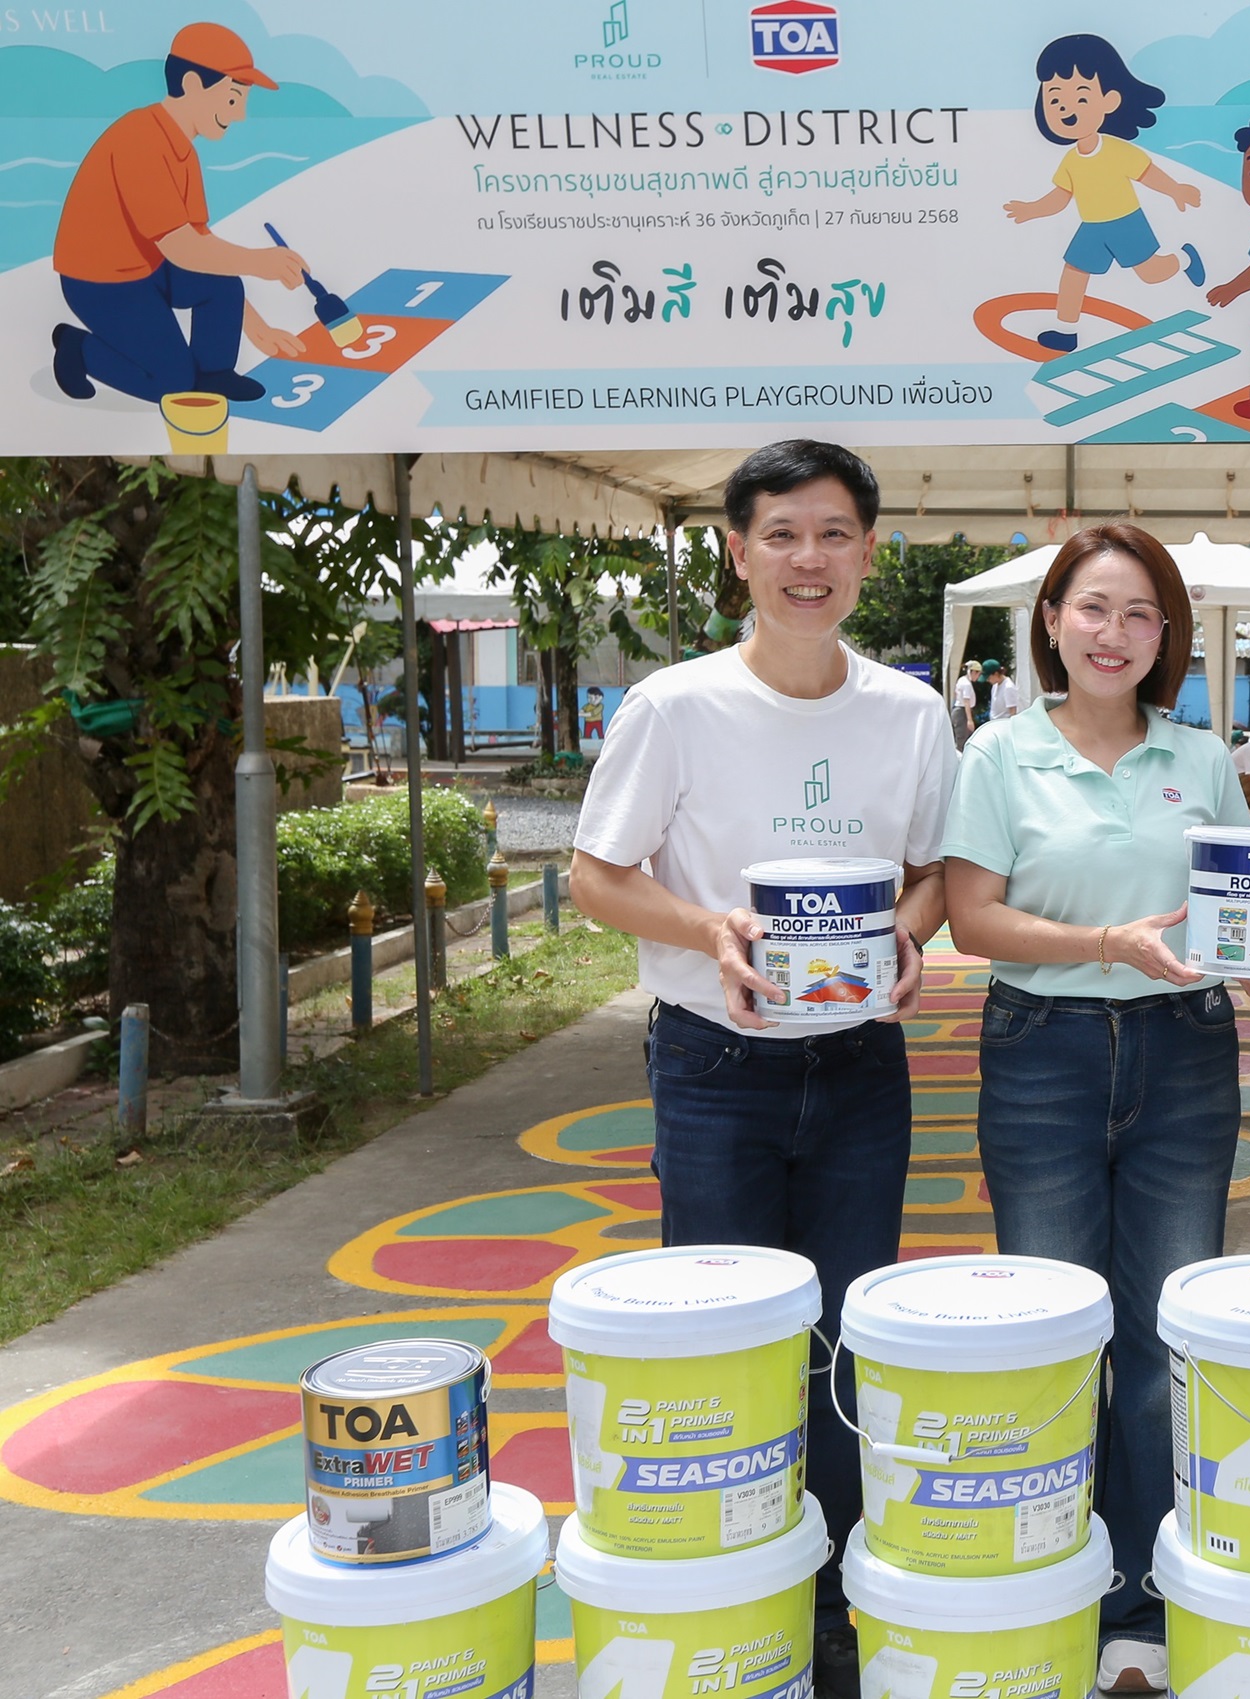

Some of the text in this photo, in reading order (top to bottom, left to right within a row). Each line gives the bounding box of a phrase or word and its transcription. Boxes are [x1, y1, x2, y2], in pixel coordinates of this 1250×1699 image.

[0, 9, 116, 33] S WELL
[754, 22, 835, 53] TOA
[574, 54, 662, 69] PROUD
[455, 107, 969, 150] WELLNESS DISTRICT
[473, 157, 958, 199] โครงการชุมชนสุขภาพดี สู่ความสุขที่ยั่งยืน
[477, 208, 959, 233] ณ โรงเรียนราชประชานุเคราะห์ 36 จังหวัดภูเก็ต 27 กันยายน 2568
[405, 281, 444, 308] 1
[560, 257, 886, 348] เติมสี เติมสุข
[342, 325, 396, 359] 3
[271, 373, 327, 409] 3
[465, 376, 993, 411] GAMIFIED LEARNING PLAYGROUND เพื่อน้อง
[1163, 791, 1181, 800] TOA
[773, 817, 864, 835] PROUD
[790, 839, 847, 848] REAL ESTATE
[785, 892, 842, 915] TOA
[772, 917, 864, 932] ROOF PAINT
[570, 1357, 587, 1373] TOA
[864, 1366, 882, 1384] TOA
[656, 1396, 722, 1412] PAINT &
[320, 1403, 419, 1443] TOA
[617, 1398, 666, 1444] 2 IN 1
[670, 1411, 735, 1428] PRIMER
[952, 1412, 1018, 1427] PAINT &
[913, 1411, 948, 1439] 2
[946, 1431, 963, 1457] 1
[966, 1426, 1031, 1443] PRIMER
[313, 1444, 434, 1476] ExtraWET
[636, 1441, 788, 1487] SEASONS
[341, 1488, 368, 1498] Adhesion
[370, 1488, 406, 1498] Breathable
[407, 1484, 429, 1494] Primer
[344, 1476, 394, 1488] PRIMER
[930, 1459, 1079, 1502] SEASONS
[737, 1488, 756, 1500] V3030
[1032, 1501, 1050, 1512] V3030
[302, 1629, 328, 1646] TOA
[618, 1620, 648, 1634] TOA
[886, 1630, 913, 1648] TOA
[730, 1629, 785, 1657] PAINT &
[743, 1640, 793, 1670] PRIMER
[409, 1648, 475, 1674] PAINT &
[992, 1661, 1052, 1683] PAINT &
[424, 1659, 487, 1688] PRIMER
[1005, 1672, 1063, 1697] PRIMER
